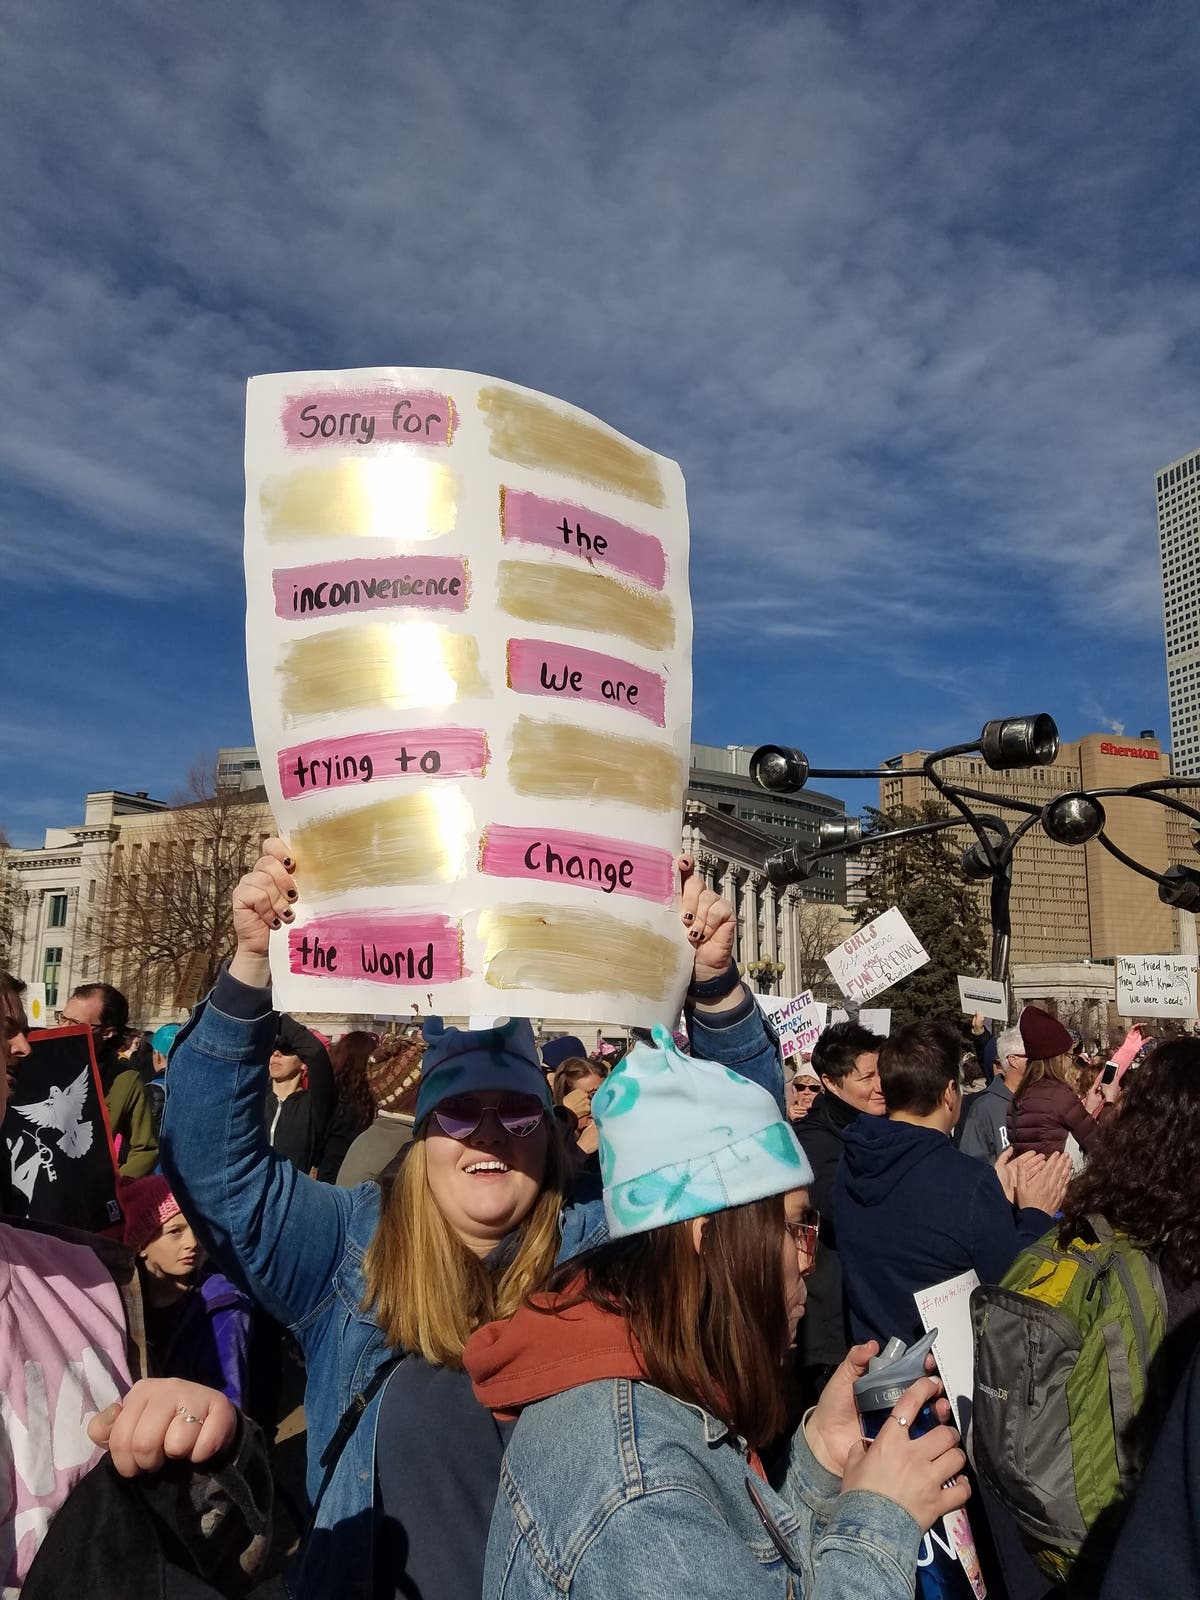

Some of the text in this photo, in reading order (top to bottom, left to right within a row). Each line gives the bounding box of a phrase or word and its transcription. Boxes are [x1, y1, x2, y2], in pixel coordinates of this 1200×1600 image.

[298, 399, 442, 445] Sorry for
[556, 516, 609, 556] the
[292, 574, 462, 614] inconvenience
[601, 679, 639, 706] are
[1100, 742, 1160, 761] Sheraton
[293, 745, 442, 789] trying to
[523, 840, 635, 894] Change
[843, 923, 878, 955] GIRLS
[295, 935, 338, 973] the
[862, 953, 881, 970] HAVE
[1118, 958, 1137, 976] They
[1140, 958, 1161, 971] tried
[1164, 959, 1171, 972] to
[1117, 975, 1134, 991] They
[792, 1019, 813, 1035] WITH
[795, 1025, 822, 1050] STORY
